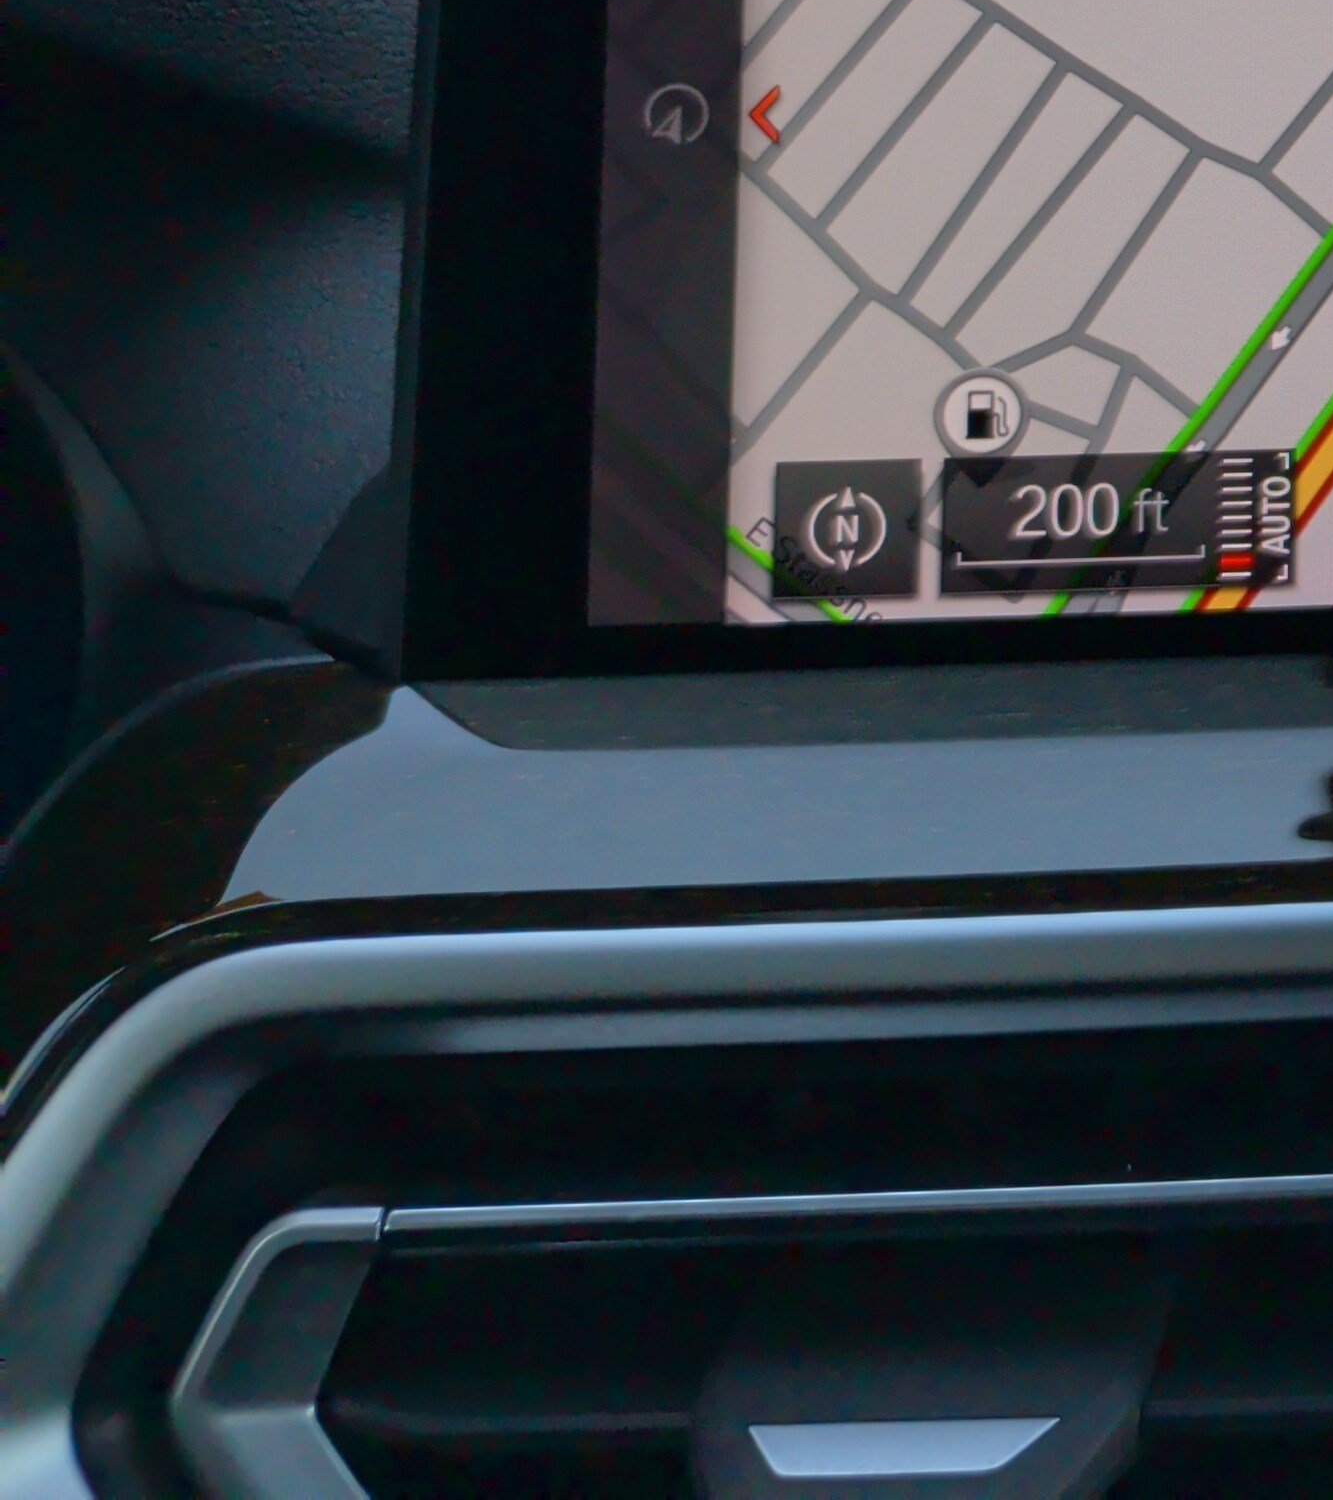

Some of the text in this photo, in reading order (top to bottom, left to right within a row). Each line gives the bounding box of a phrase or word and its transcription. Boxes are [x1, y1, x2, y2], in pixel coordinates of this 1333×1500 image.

[1013, 482, 1170, 538] 200 ft
[1260, 474, 1292, 555] AUTO
